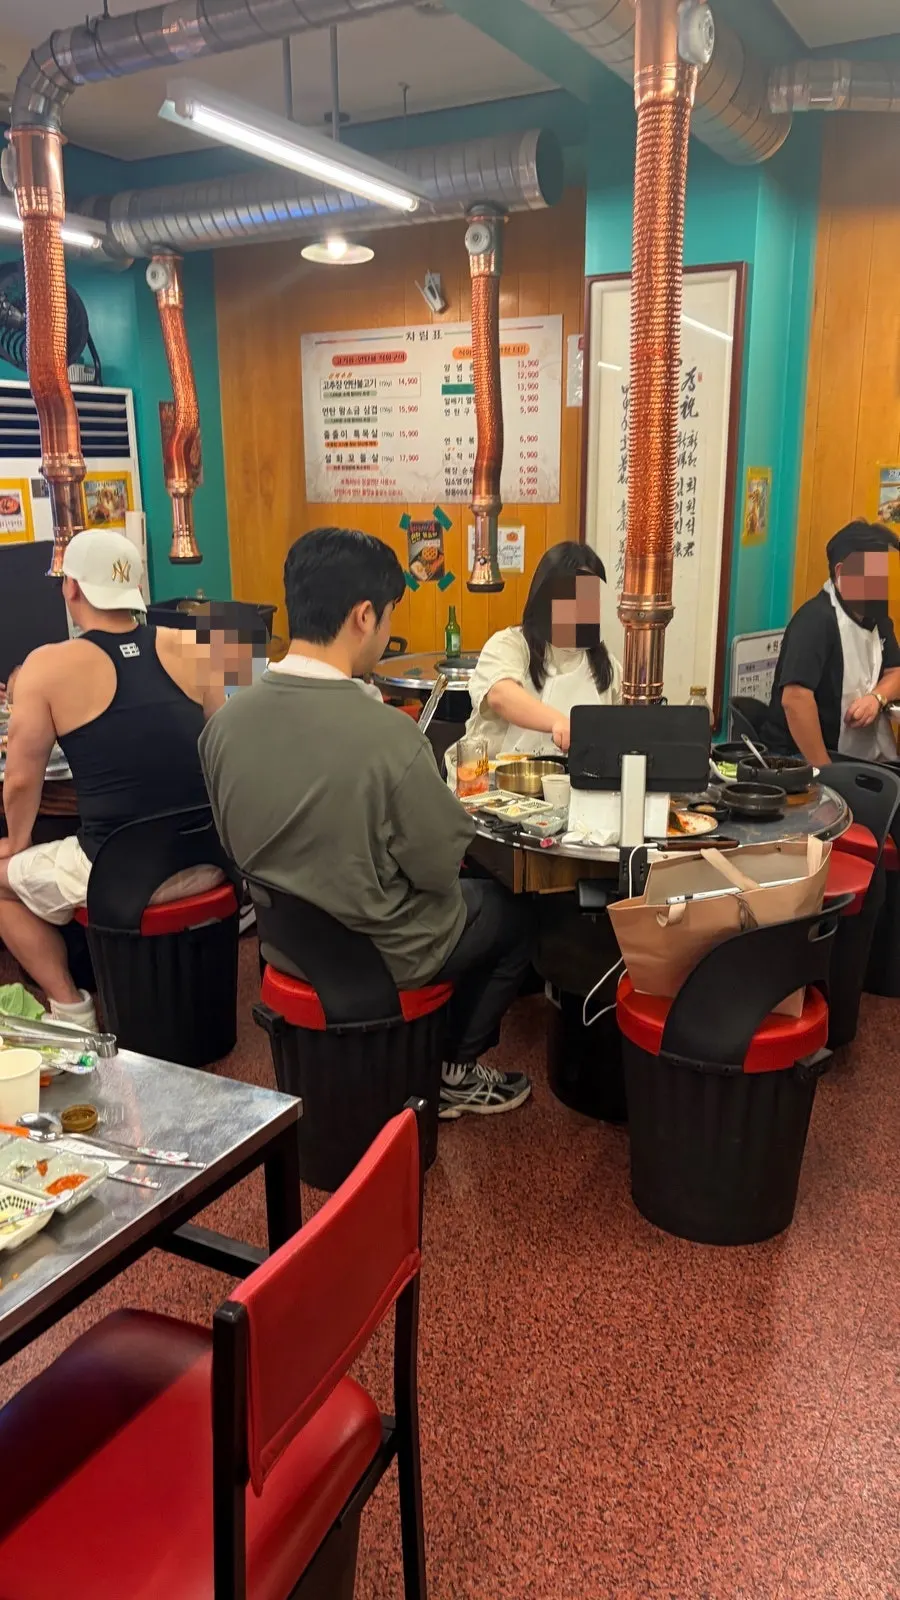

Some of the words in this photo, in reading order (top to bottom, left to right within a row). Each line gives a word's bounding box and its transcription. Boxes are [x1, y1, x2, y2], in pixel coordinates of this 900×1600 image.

[517, 371, 540, 381] 12,900
[322, 379, 342, 391] 고추장
[398, 377, 418, 386] 14,900
[520, 395, 539, 404] 9,900
[398, 404, 419, 414] 15,900
[520, 406, 539, 415] 5,900
[399, 429, 419, 439] 15,900
[519, 434, 539, 444] 6,900
[399, 453, 419, 463] 17,900
[519, 451, 538, 460] 6,900
[519, 465, 538, 475] 6,900
[519, 477, 538, 486] 6,900
[112, 558, 131, 584] NY
